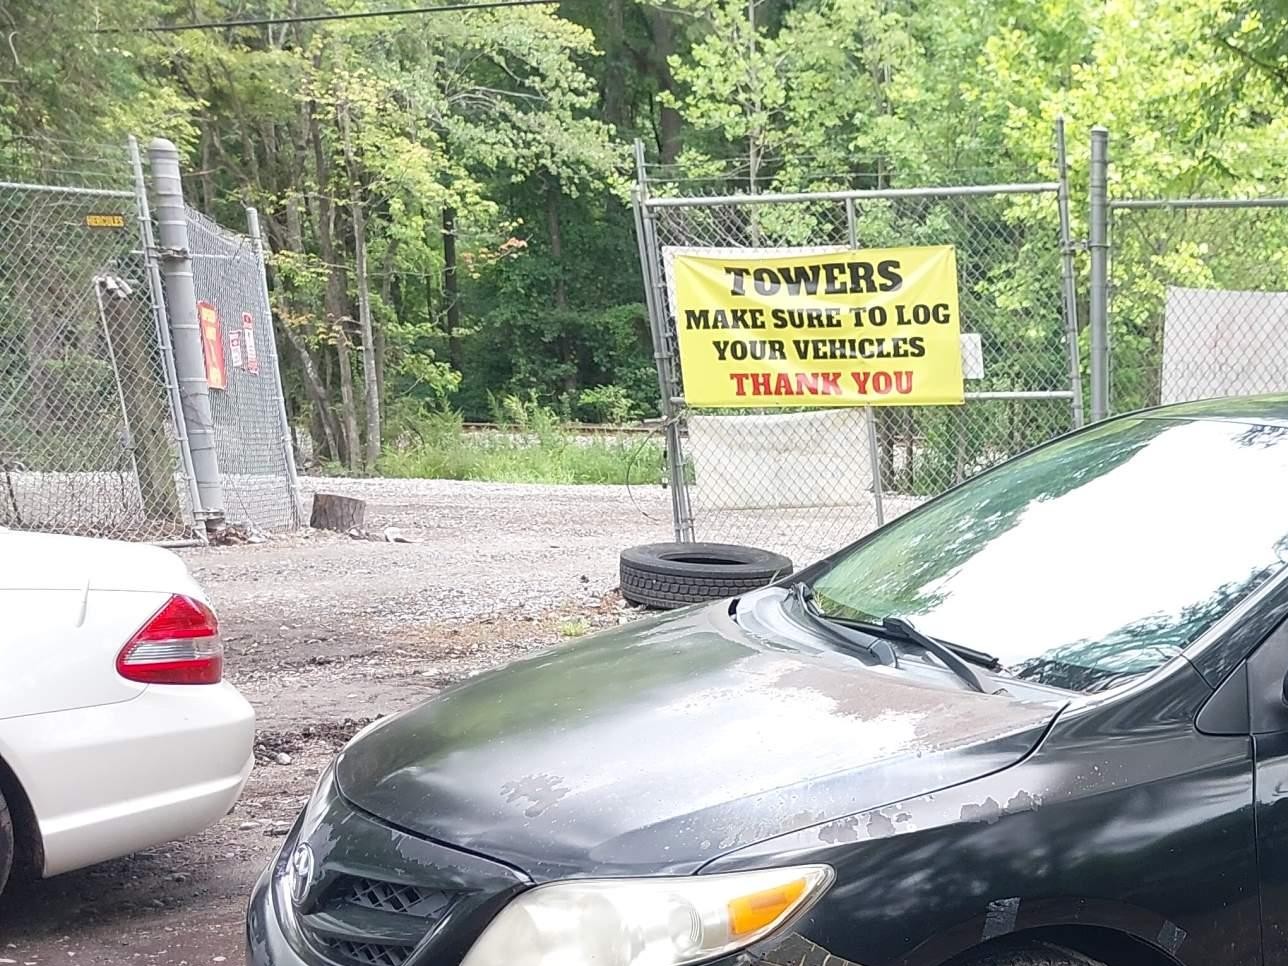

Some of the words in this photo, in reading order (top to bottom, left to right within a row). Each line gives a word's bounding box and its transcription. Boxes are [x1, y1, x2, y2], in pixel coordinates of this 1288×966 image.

[725, 260, 904, 297] TOWERS
[685, 309, 766, 330] MAKE
[772, 307, 842, 329] SURE
[850, 305, 888, 327] TO
[895, 303, 951, 326] LOG
[712, 339, 788, 361] YOUR
[792, 336, 926, 360] VEHICLES
[730, 372, 842, 397] THANK
[852, 370, 914, 395] YOU
